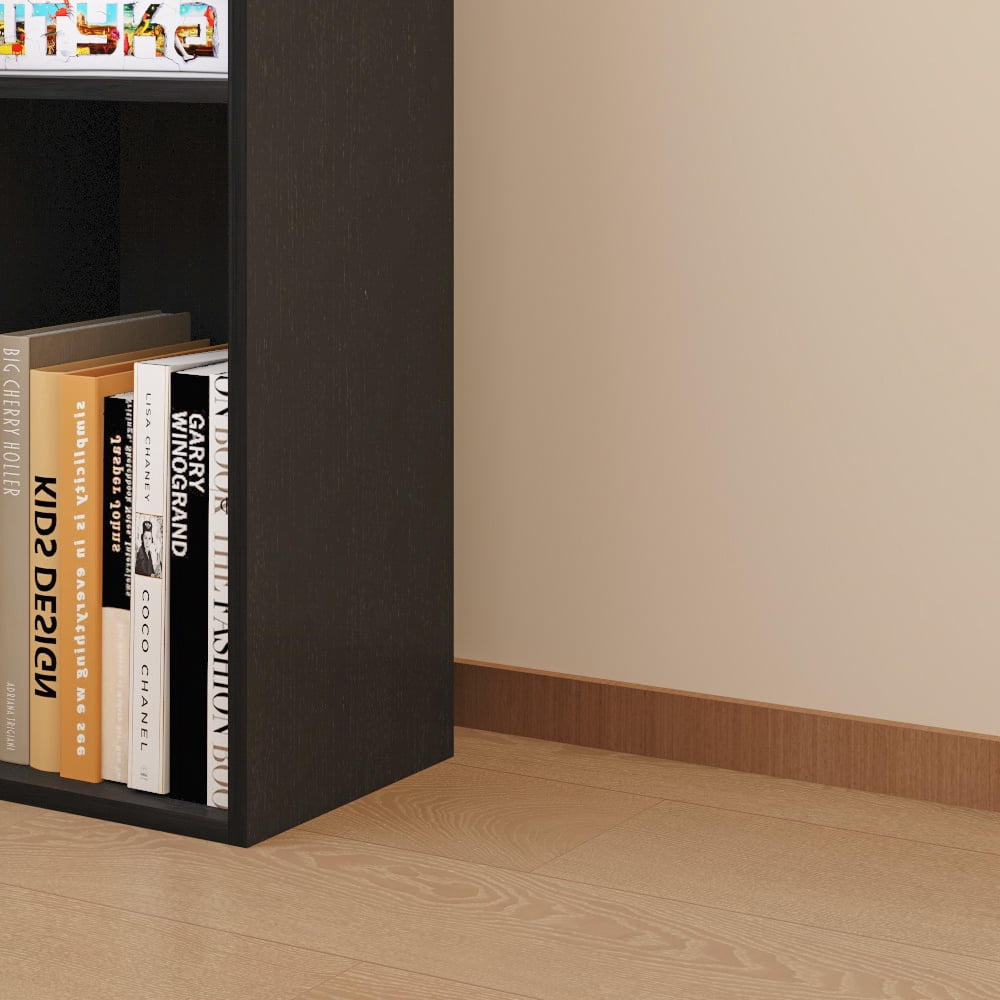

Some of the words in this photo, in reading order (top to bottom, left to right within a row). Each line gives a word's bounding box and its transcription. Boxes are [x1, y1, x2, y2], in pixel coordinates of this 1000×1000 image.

[3, 348, 20, 372] BIG
[3, 380, 20, 435] CHERRY
[3, 442, 20, 496] HOLLER
[188, 412, 205, 494] GARRY
[171, 411, 188, 558] WINOGRAND
